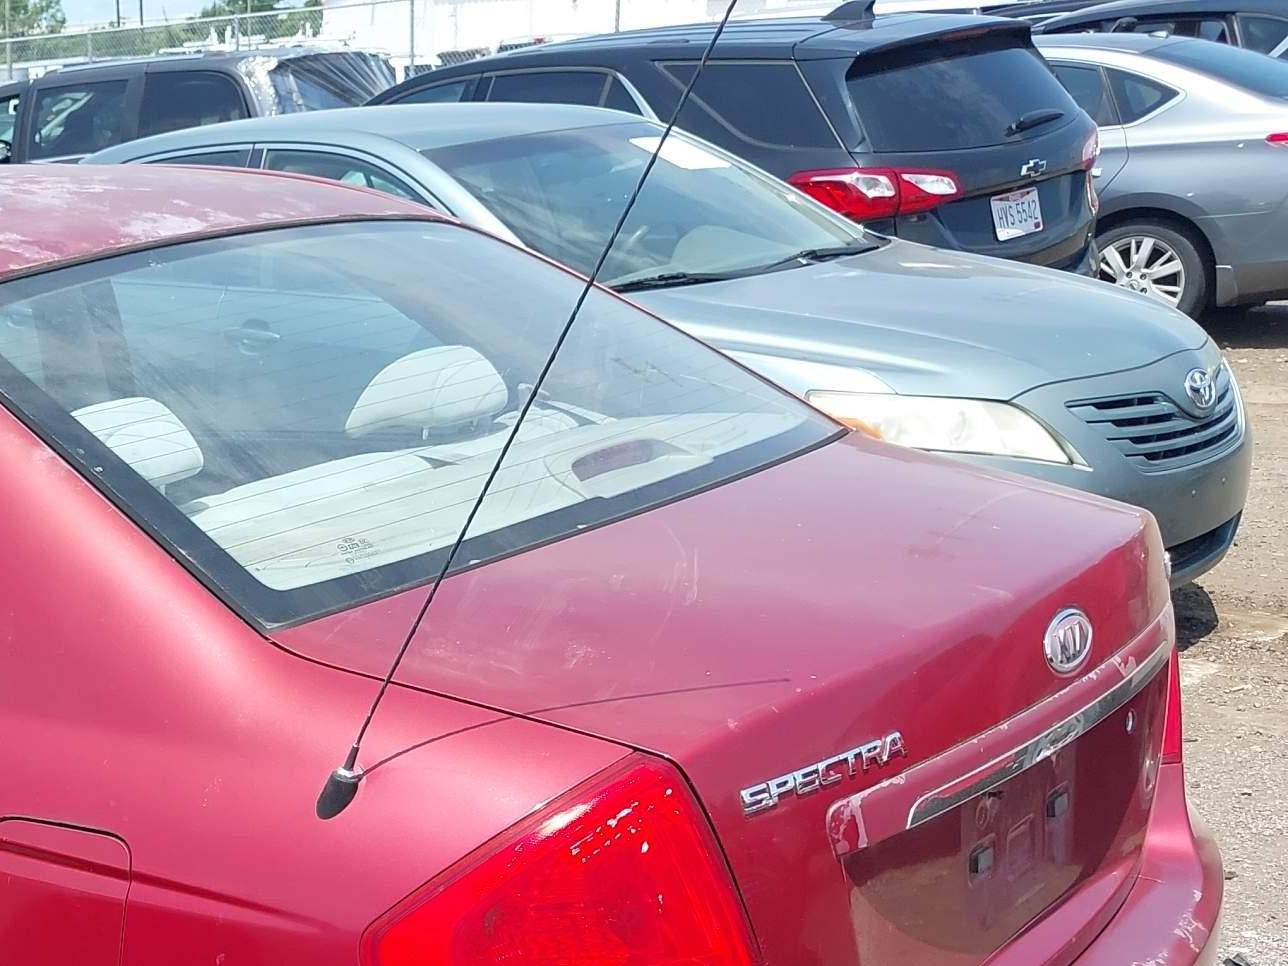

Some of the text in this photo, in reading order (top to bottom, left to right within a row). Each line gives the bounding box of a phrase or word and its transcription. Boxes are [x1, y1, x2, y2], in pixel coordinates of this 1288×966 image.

[1015, 200, 1039, 224] 5542
[1048, 617, 1090, 667] KIA
[739, 731, 909, 816] SPECTRA
